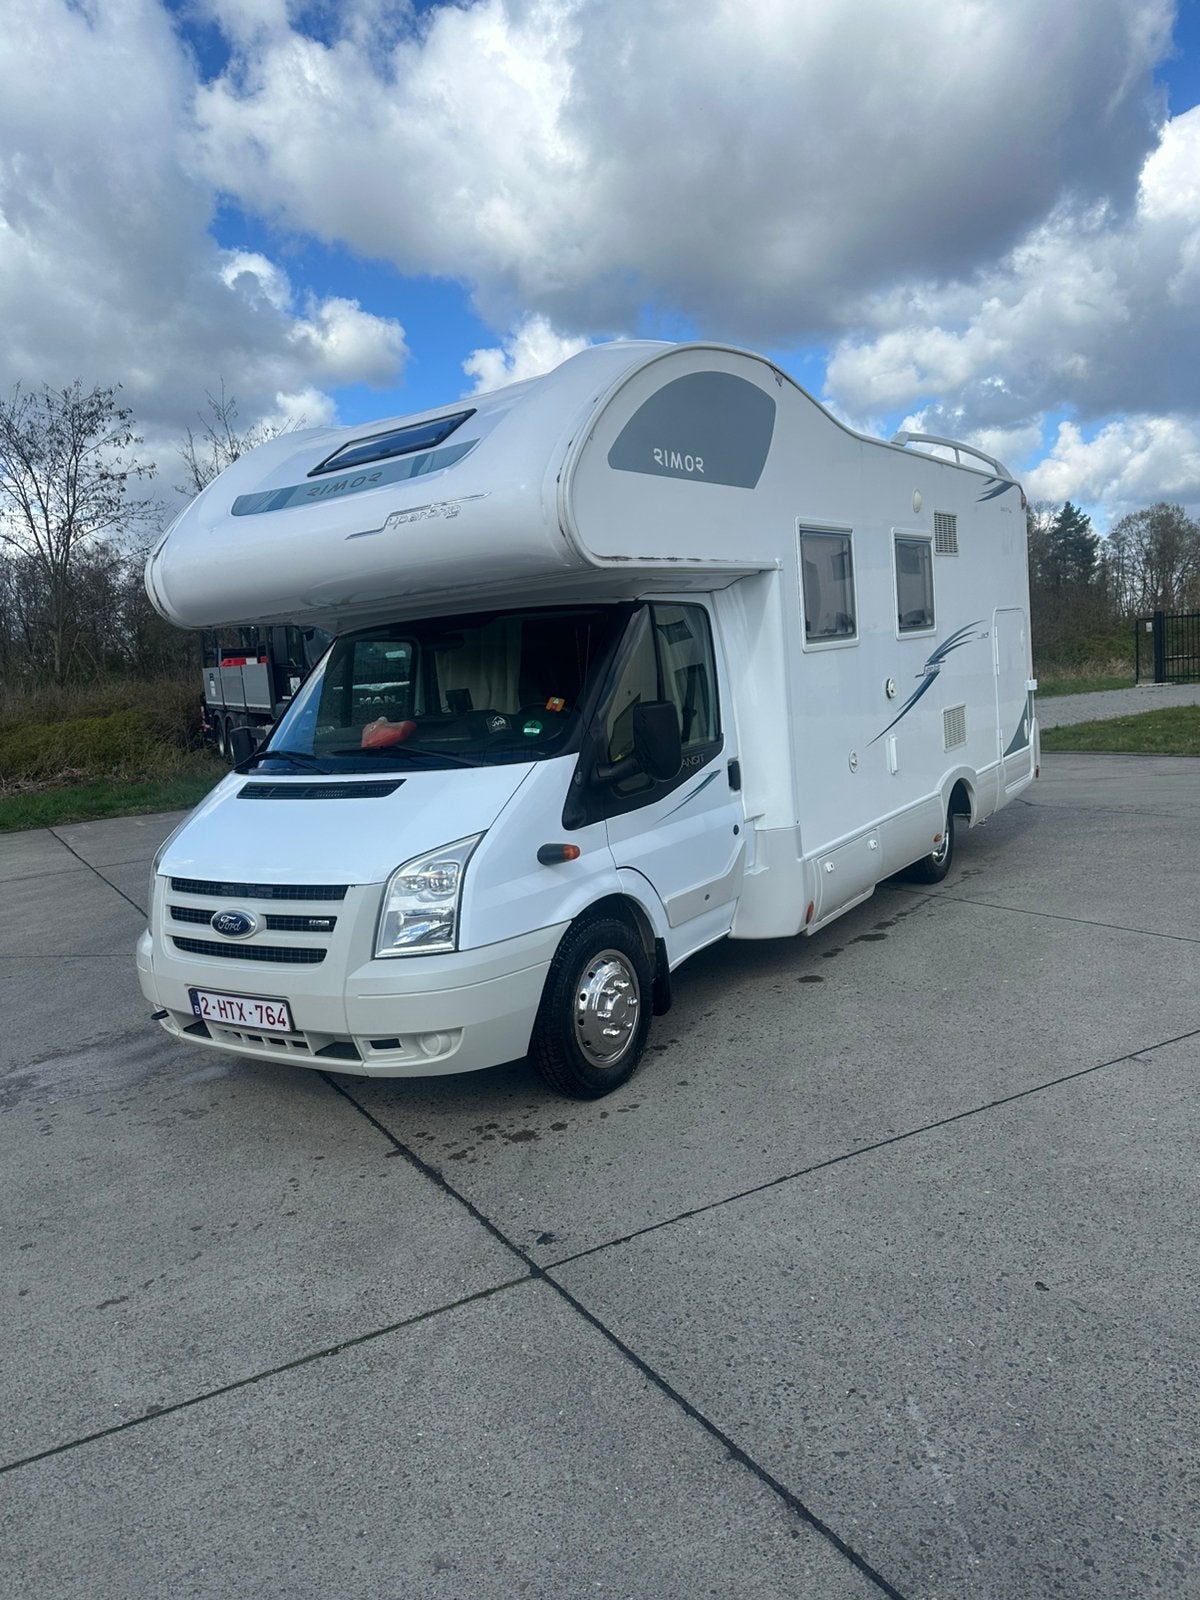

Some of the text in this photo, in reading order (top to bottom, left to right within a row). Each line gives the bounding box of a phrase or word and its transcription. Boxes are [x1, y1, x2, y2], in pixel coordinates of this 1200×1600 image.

[654, 447, 705, 473] RIMOR
[307, 471, 383, 497] RIMOR
[680, 753, 705, 769] ANSIT
[217, 915, 242, 932] Ford
[200, 996, 287, 1027] 2-HTX-764
